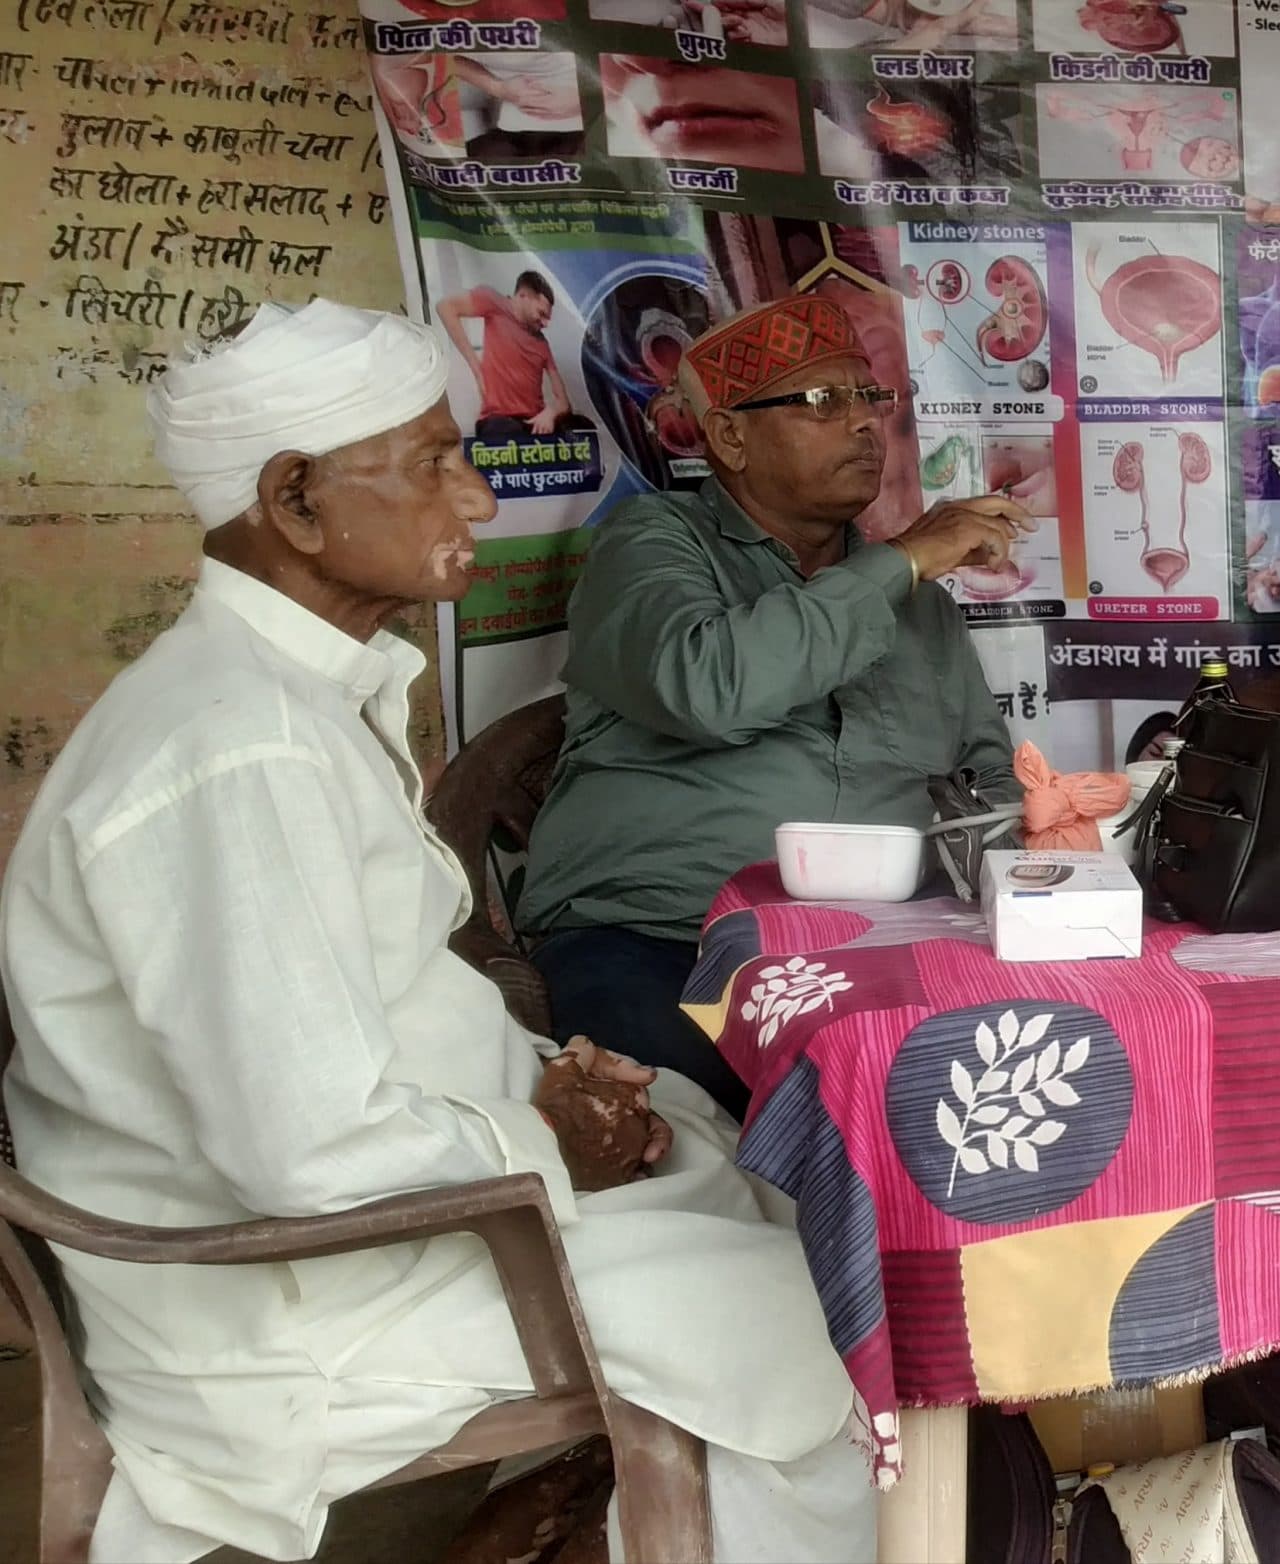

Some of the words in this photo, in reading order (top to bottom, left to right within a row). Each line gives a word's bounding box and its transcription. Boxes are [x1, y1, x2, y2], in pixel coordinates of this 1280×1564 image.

[377, 24, 432, 50] पित्त
[437, 18, 474, 47] की
[477, 17, 540, 47] पथरी
[676, 30, 726, 59] शुगर
[873, 54, 920, 77] ब्लड
[921, 51, 974, 78] प्रेशर
[1052, 53, 1120, 81] किडनी
[1124, 54, 1153, 80] की
[1157, 56, 1210, 82] पथरी
[667, 167, 737, 193] एलर्जी
[835, 181, 867, 205] पेट
[891, 181, 933, 205] गैस
[933, 185, 955, 205] व
[955, 186, 1010, 205] कब्ज
[914, 223, 979, 242] Kidney
[983, 225, 1046, 240] stones
[920, 403, 982, 415] KIDNEY
[993, 402, 1045, 415] STONE
[1084, 404, 1151, 415] BLADDER
[1160, 404, 1208, 415] STONE
[471, 439, 518, 467] किडनी
[521, 438, 557, 464] स्टोन
[558, 437, 572, 462] के
[574, 438, 592, 462] दर्द
[488, 469, 502, 489] से
[506, 468, 532, 486] पाएं
[532, 469, 585, 493] छुटकारा
[1019, 604, 1054, 615] STONE
[1095, 603, 1148, 614] URETER
[1157, 603, 1202, 614] STONE
[1050, 638, 1141, 668] अंडाशय
[1147, 638, 1168, 668] में
[1228, 644, 1262, 667] का
[1018, 681, 1039, 720] हैं
